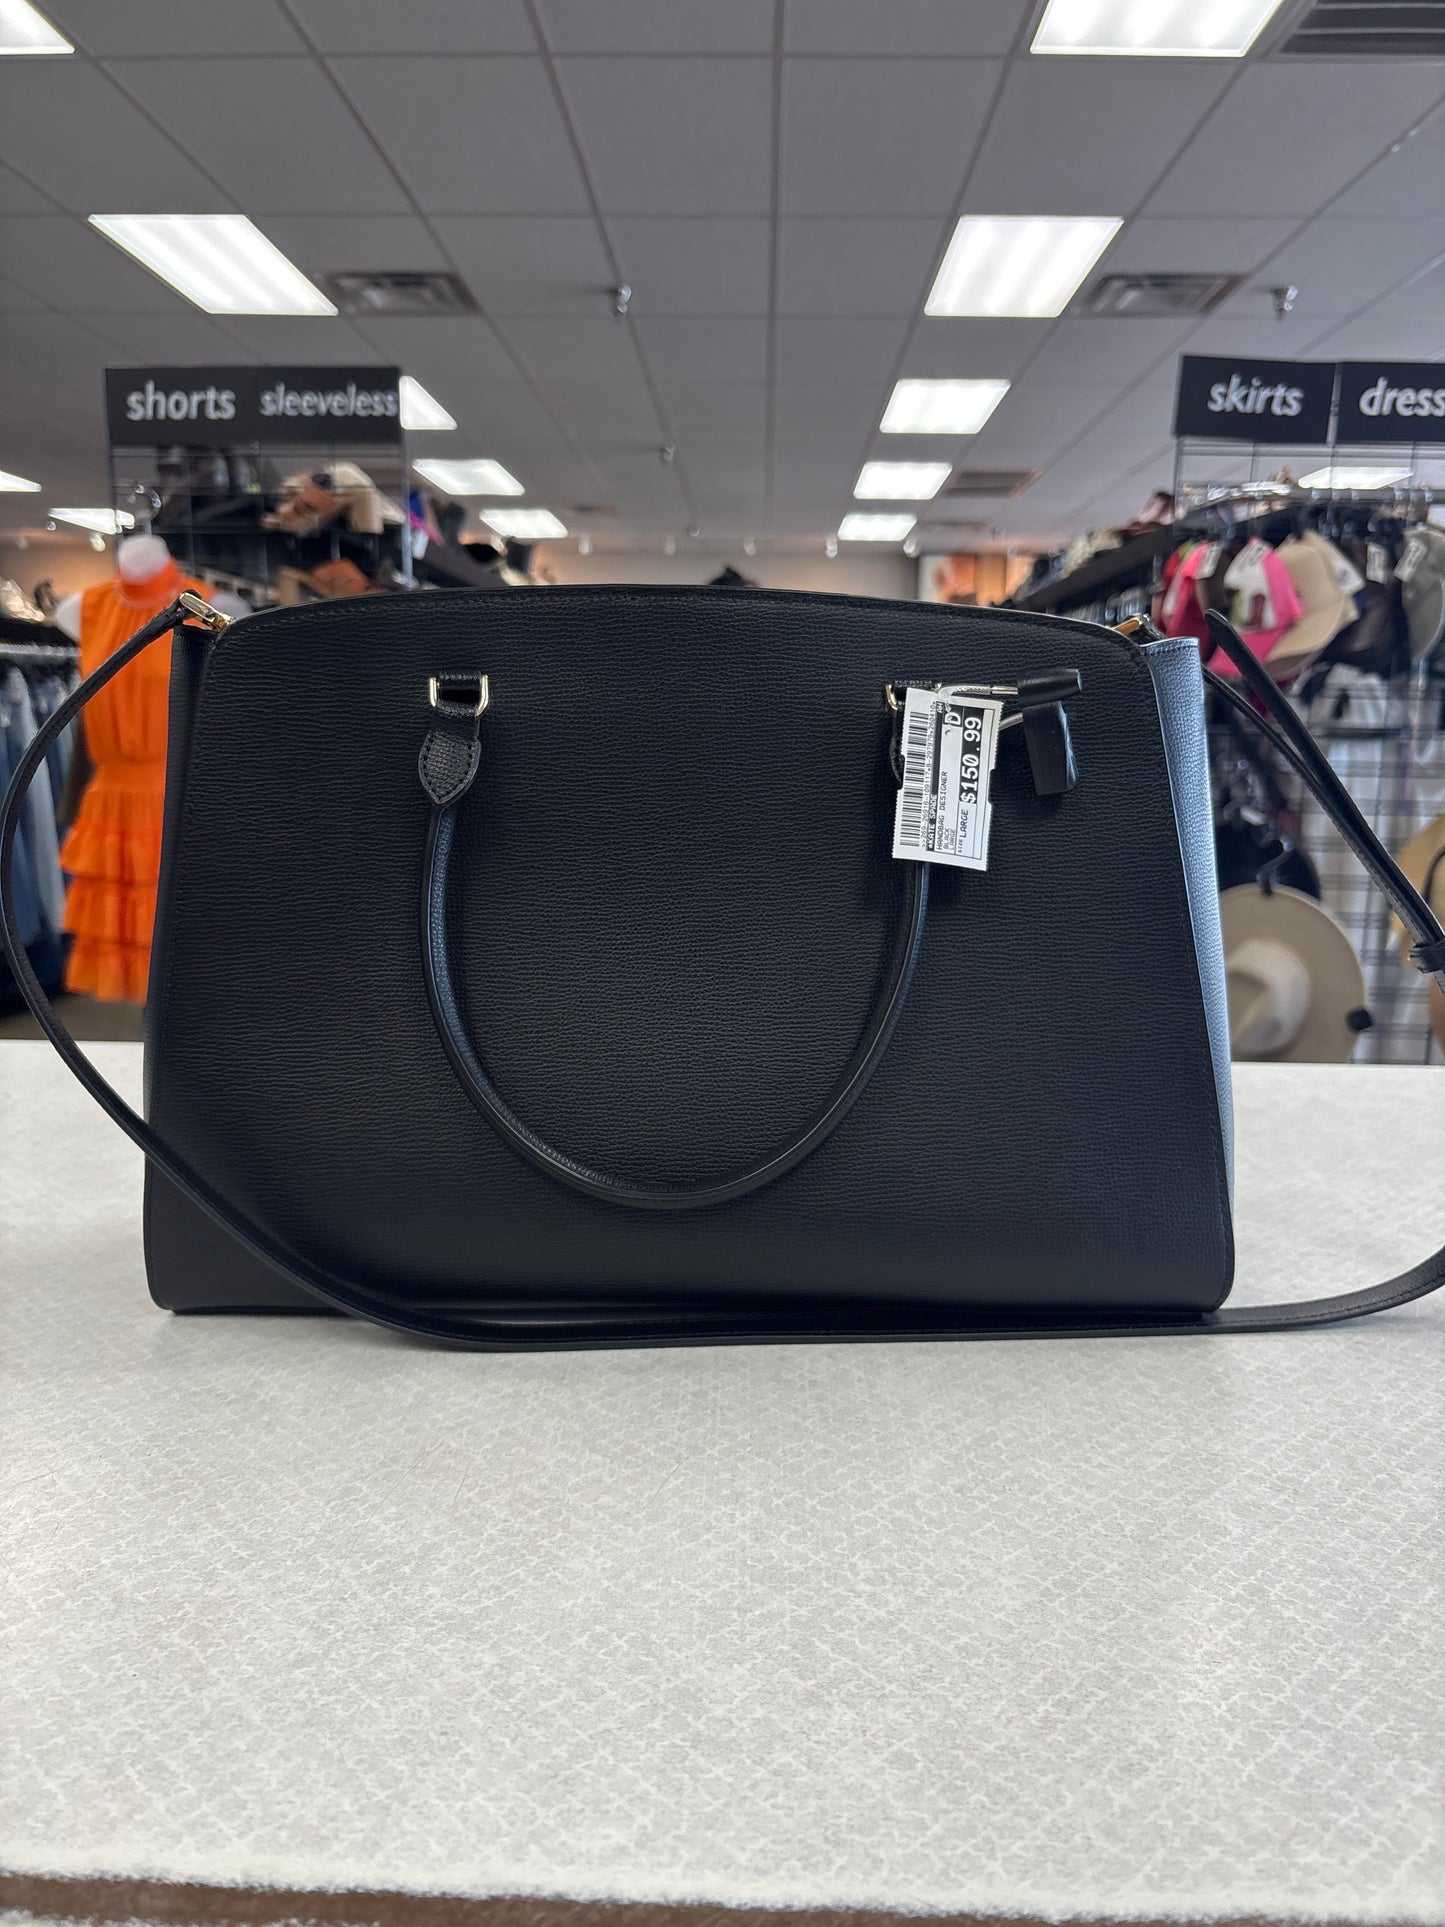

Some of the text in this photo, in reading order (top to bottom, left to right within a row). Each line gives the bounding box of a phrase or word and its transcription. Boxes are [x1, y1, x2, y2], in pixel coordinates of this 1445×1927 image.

[126, 380, 236, 422] shorts
[260, 381, 399, 418] sleeveless
[1207, 373, 1304, 417] skirts
[1359, 376, 1445, 418] dress
[960, 716, 982, 804] $150.99
[929, 794, 938, 820] SPADE
[936, 771, 948, 850] HANDBAG DESIGNER
[960, 808, 969, 839] LARGE
[943, 827, 951, 850] BLACK
